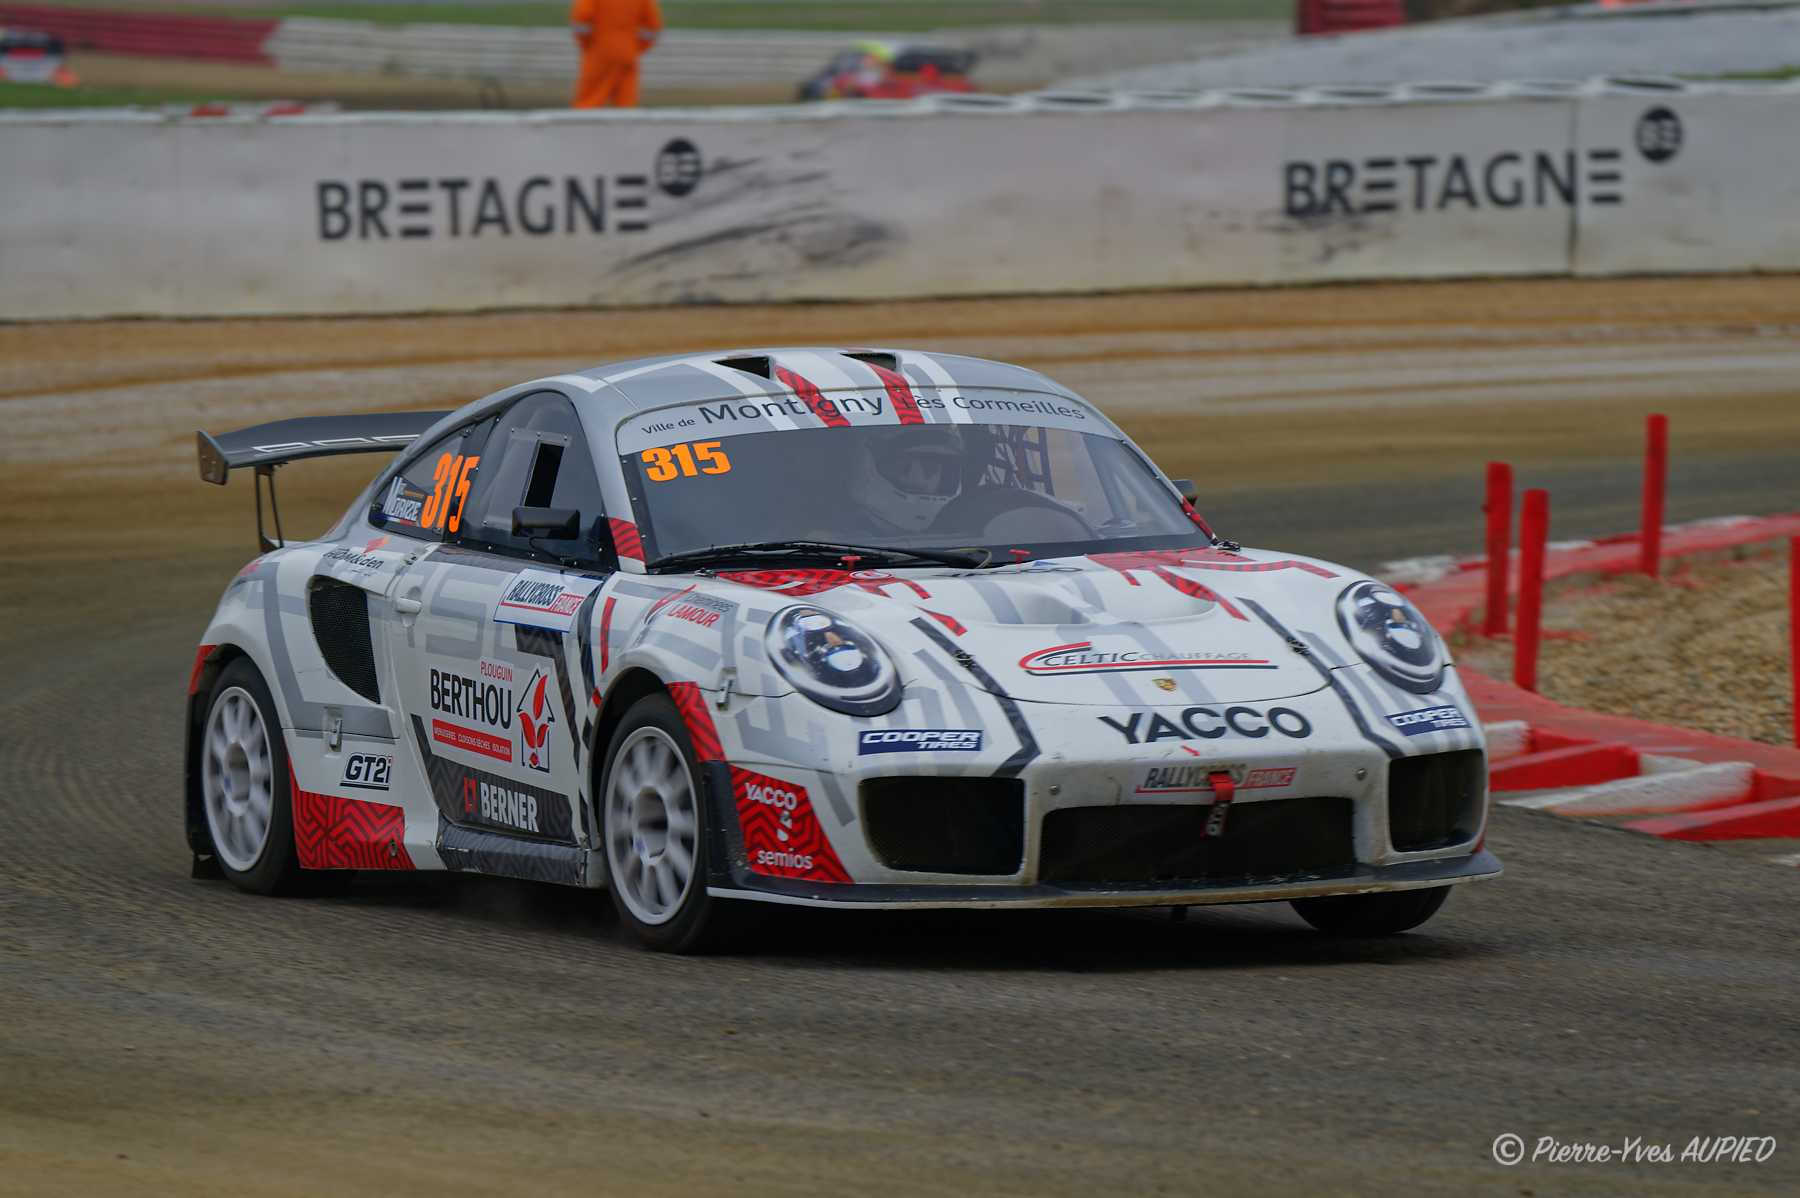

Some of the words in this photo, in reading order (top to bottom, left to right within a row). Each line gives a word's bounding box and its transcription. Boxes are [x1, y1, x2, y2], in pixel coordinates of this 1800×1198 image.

[1282, 149, 1623, 217] BRETAGNE
[317, 175, 647, 241] BRETAGNE
[641, 419, 675, 434] Ville
[678, 416, 696, 428] de
[698, 395, 883, 424] Montigny
[952, 396, 1086, 420] Cormeilles
[641, 441, 732, 482] 315
[421, 451, 480, 533] 315
[480, 661, 512, 682] PLOUGUIN
[1044, 651, 1140, 667] CELTIC
[430, 668, 512, 730] BERTHOU
[1097, 706, 1312, 744] YACCO
[1391, 708, 1463, 726] COOPER
[862, 731, 980, 743] COOPER
[917, 741, 977, 749] TIRES
[345, 753, 393, 783] GT2i
[480, 781, 539, 833] BERNER
[744, 782, 798, 810] YACCO
[757, 847, 813, 870] semios
